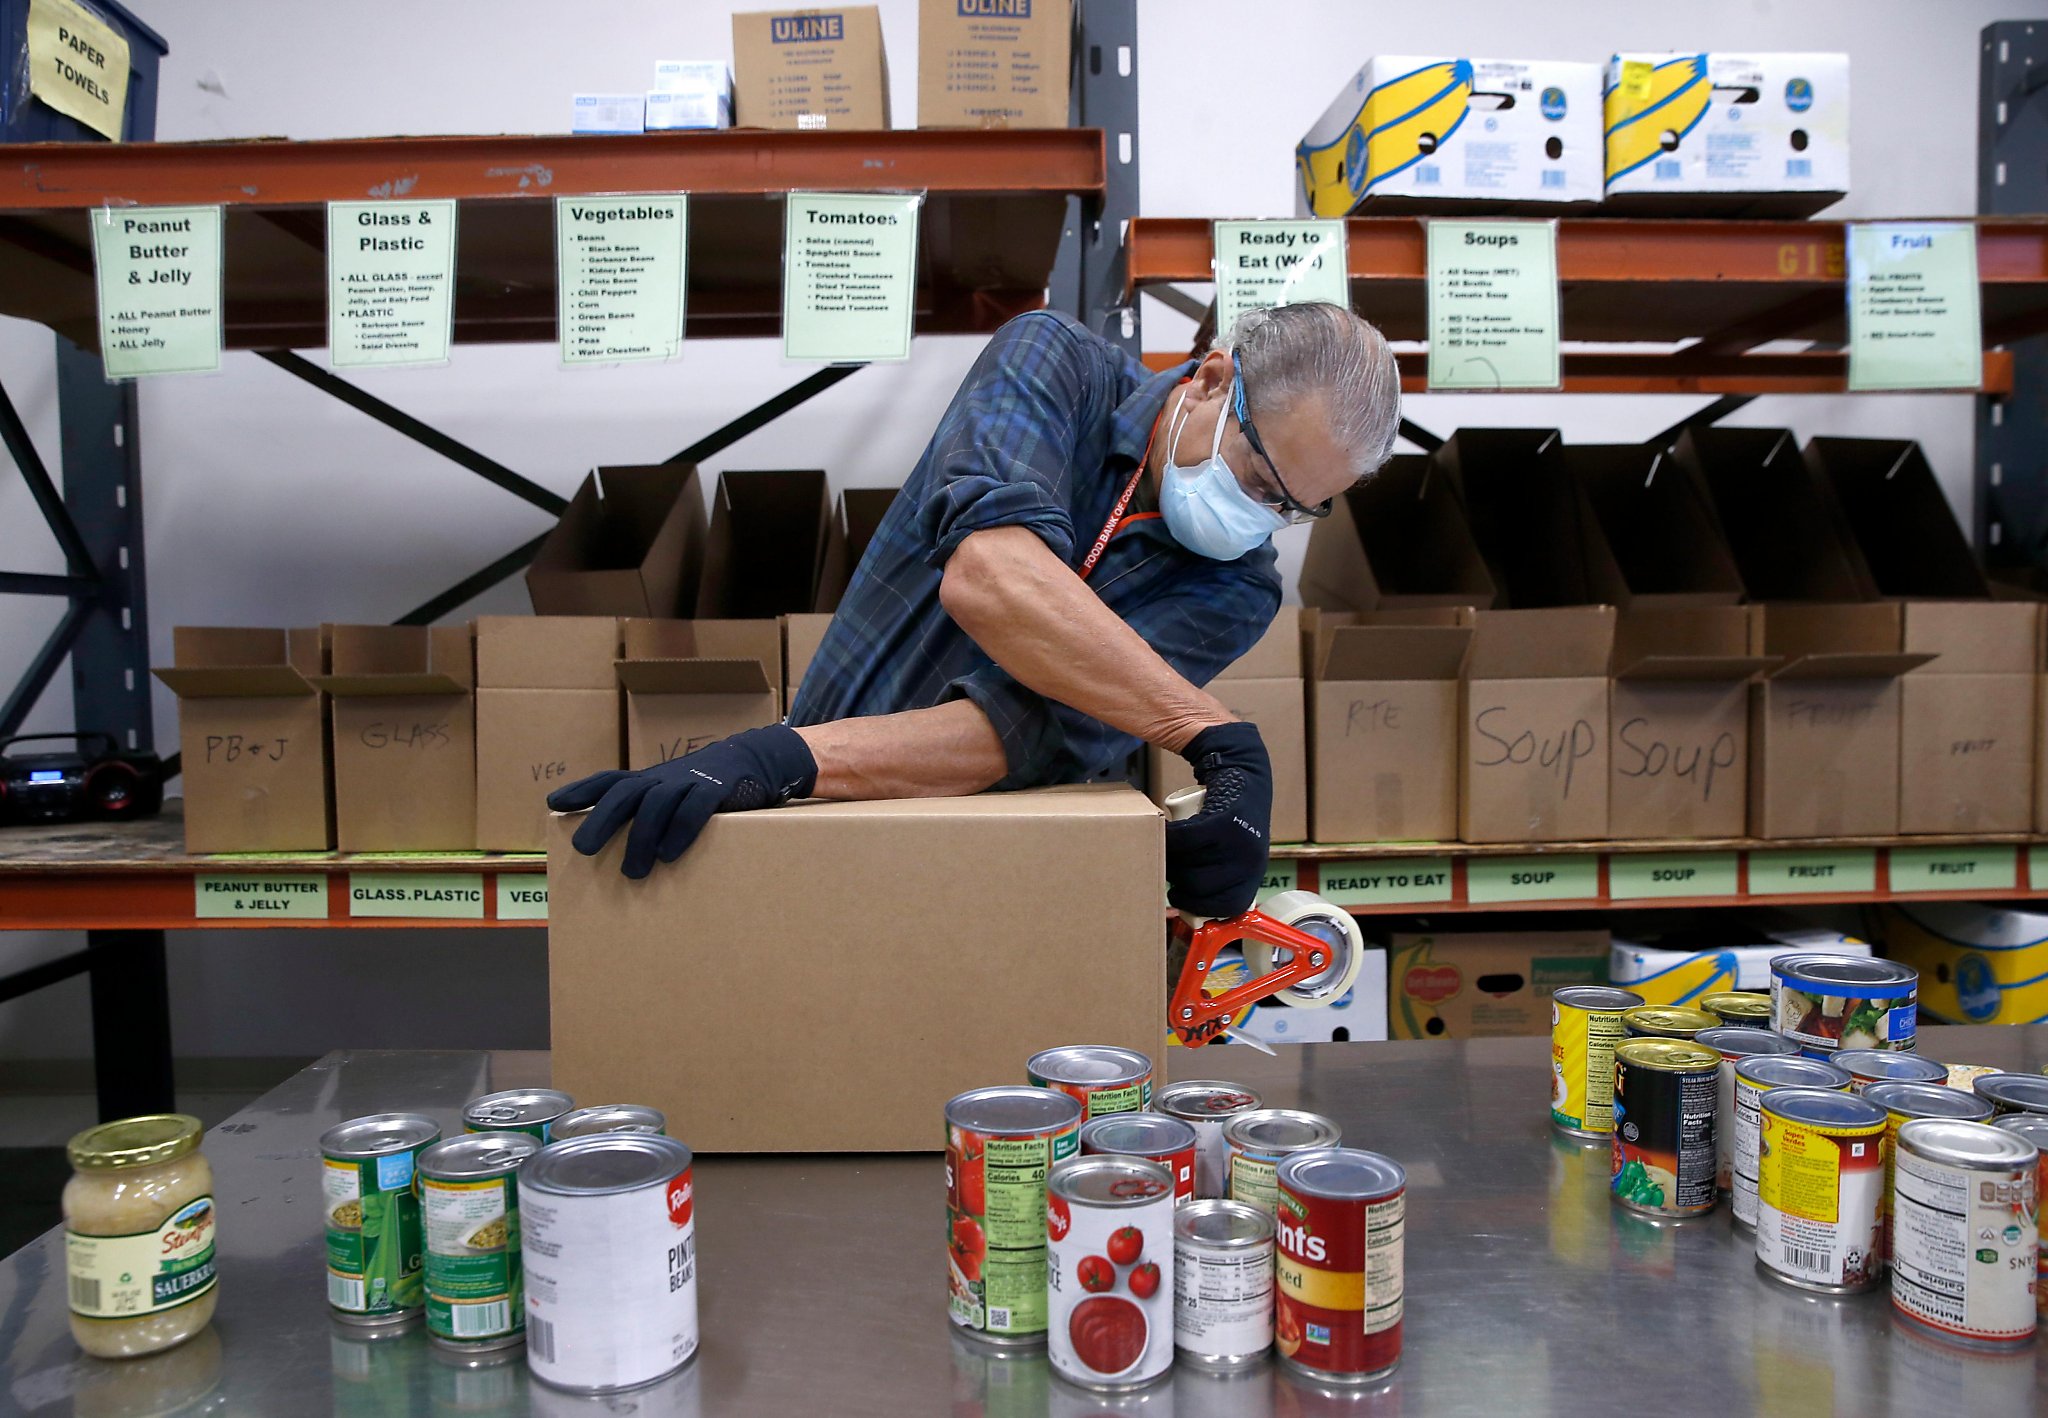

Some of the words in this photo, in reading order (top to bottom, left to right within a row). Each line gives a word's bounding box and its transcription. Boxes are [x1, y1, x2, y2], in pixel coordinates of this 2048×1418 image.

[962, 0, 1027, 15] ULINE
[774, 18, 840, 40] ULINE
[58, 26, 105, 70] PAPER
[54, 58, 110, 106] TOWELS
[358, 211, 410, 226] Glass
[418, 211, 432, 225] &
[571, 206, 674, 224] Vegetables
[806, 210, 898, 226] Tomatoes
[124, 218, 192, 234] Peanut
[360, 237, 424, 251] Plastic
[834, 238, 874, 246] (canned)
[1240, 231, 1296, 247] Ready
[1302, 231, 1320, 244] to
[1464, 232, 1518, 249] Soups
[1892, 235, 1932, 248] Fruit
[130, 245, 189, 259] Butter
[806, 250, 850, 258] Spaghetti
[1239, 255, 1269, 268] Eat
[1276, 254, 1322, 270] (W)
[128, 270, 141, 285] &
[148, 269, 192, 286] Jelly
[348, 274, 368, 283] ALL
[372, 273, 408, 282] GLASS
[588, 267, 617, 275] Kidney
[378, 286, 406, 294] Butter,
[601, 289, 637, 297] Peppers
[1486, 292, 1508, 300] Soup
[348, 298, 370, 306] Jelly,
[389, 296, 408, 304] Baby
[118, 312, 137, 321] ALL
[140, 310, 176, 319] Peanut
[179, 308, 212, 317] Butter
[348, 308, 394, 318] PLASTIC
[118, 326, 150, 335] Honey
[119, 340, 138, 349] ALL
[141, 339, 166, 348] Jelly
[606, 346, 650, 355] Chestnuts
[1083, 542, 1104, 568] FOOD
[1100, 515, 1119, 542] BANK
[1114, 502, 1125, 516] OF
[1345, 698, 1401, 736] RTE
[360, 722, 450, 749] GLASS
[1475, 706, 1595, 800] Soup
[1618, 717, 1737, 802] Soup
[532, 761, 566, 782] VEG
[1789, 864, 1836, 878] FRUIT
[1930, 861, 1976, 875] FRUIT
[1259, 876, 1290, 889] EAT
[1326, 877, 1380, 891] READY
[1386, 876, 1410, 888] TO
[1414, 873, 1446, 886] EAT
[1511, 872, 1555, 885] SOUP
[1652, 869, 1696, 882] SOUP
[204, 882, 260, 894] PEANUT
[264, 882, 319, 894] BUTTER
[510, 890, 548, 903] VEG
[234, 900, 244, 910] &
[248, 900, 291, 910] JELLY
[1589, 1014, 1619, 1023] Nutrition
[1091, 1092, 1122, 1101] Nutrition
[1122, 1088, 1138, 1098] Facts
[1683, 1112, 1712, 1120] Nutrition
[987, 1142, 1022, 1152] Nutrition
[1024, 1142, 1044, 1151] Facts
[987, 1172, 1020, 1181] Calories
[1032, 1169, 1045, 1180] 40
[1234, 1160, 1258, 1172] Nutrition
[1259, 1166, 1276, 1176] Fact
[1367, 1200, 1399, 1215] Nutrition
[1367, 1235, 1392, 1247] Calories
[1917, 1271, 1964, 1292] Calories
[1910, 1296, 1964, 1322] Nutrition
